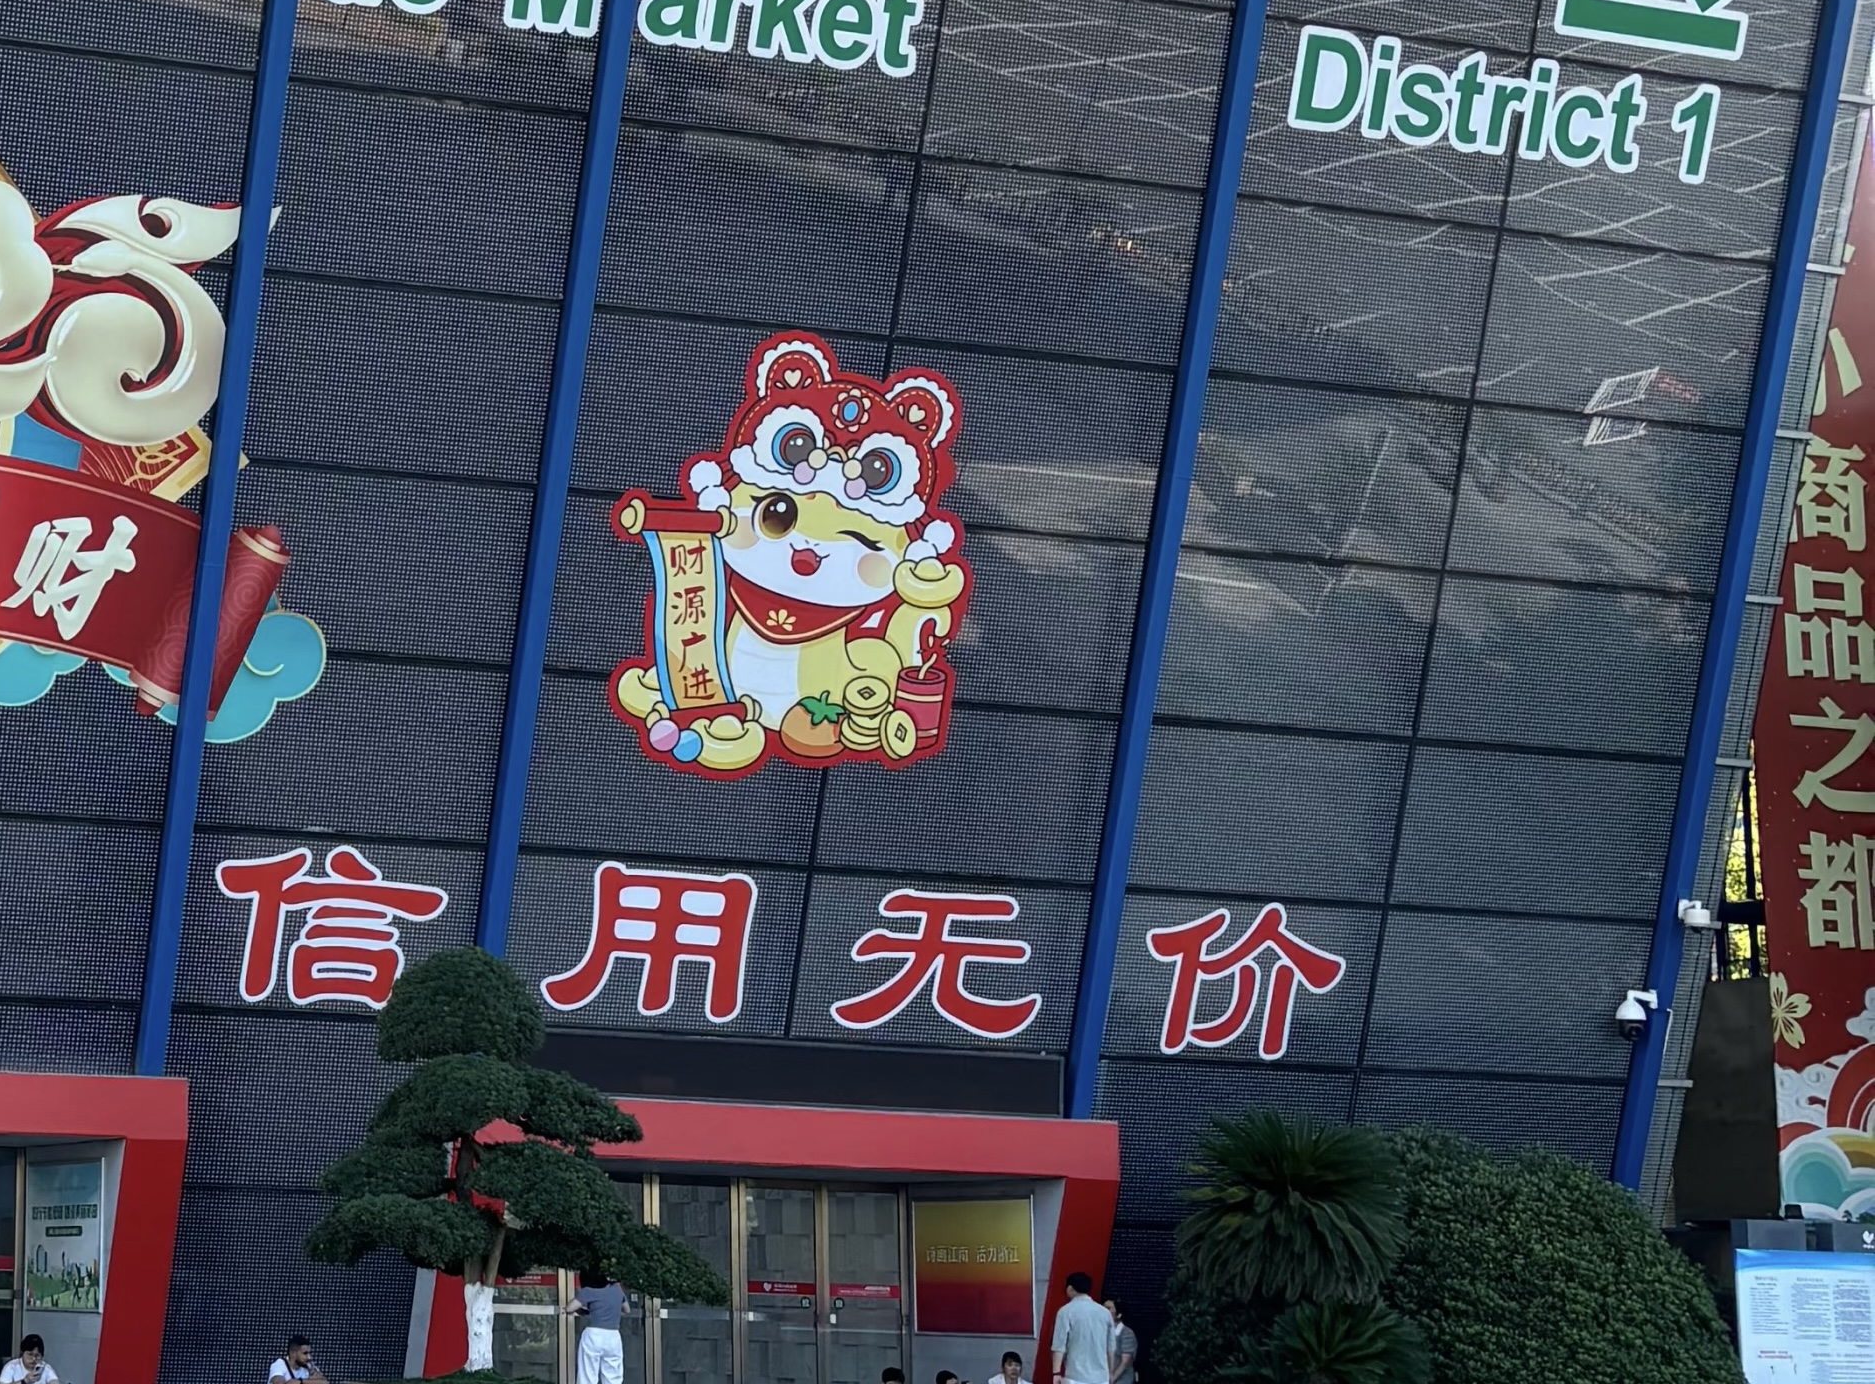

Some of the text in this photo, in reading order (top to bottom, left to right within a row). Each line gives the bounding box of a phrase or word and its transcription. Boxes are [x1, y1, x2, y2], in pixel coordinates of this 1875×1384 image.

[1287, 24, 1644, 171] District
[1670, 84, 1722, 185] 1
[669, 540, 716, 701] 财源广进
[215, 844, 1346, 1061] 信用无价
